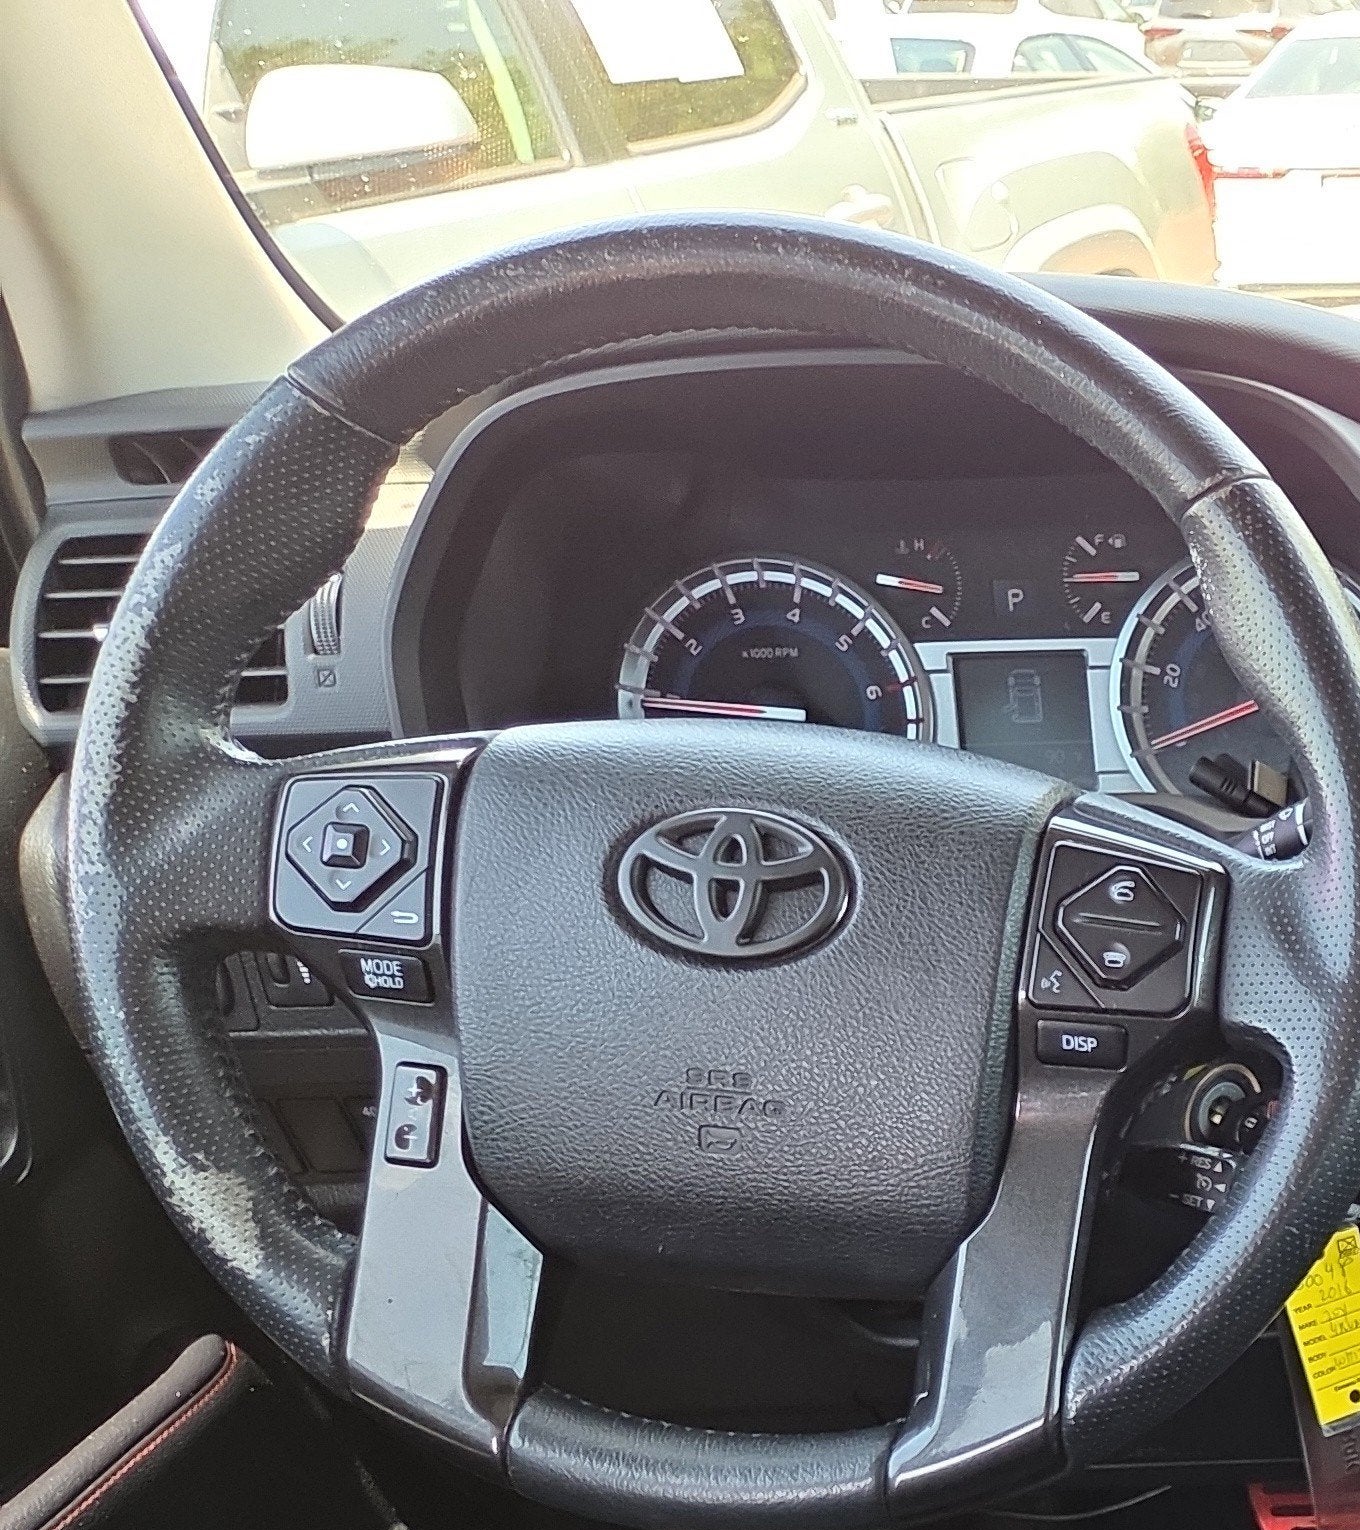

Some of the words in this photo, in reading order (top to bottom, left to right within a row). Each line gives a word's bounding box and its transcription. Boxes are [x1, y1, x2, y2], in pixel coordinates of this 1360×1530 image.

[913, 538, 925, 551] H
[1007, 588, 1024, 612] P
[730, 608, 746, 625] 3
[785, 608, 801, 625] 4
[921, 616, 932, 629] C
[683, 638, 704, 656] 2
[774, 646, 799, 658] RPM
[835, 634, 854, 653] 5
[1162, 663, 1181, 689] 20
[866, 684, 883, 701] 6
[360, 957, 404, 977] MODE
[375, 975, 404, 989] HOLD
[1061, 1034, 1098, 1053] DISP
[685, 1066, 751, 1089] SRS
[653, 1088, 783, 1119] AIRBAG
[1293, 1303, 1313, 1315] YEAR
[1303, 1334, 1328, 1347] MODEL
[1312, 1366, 1337, 1380] COLOR
